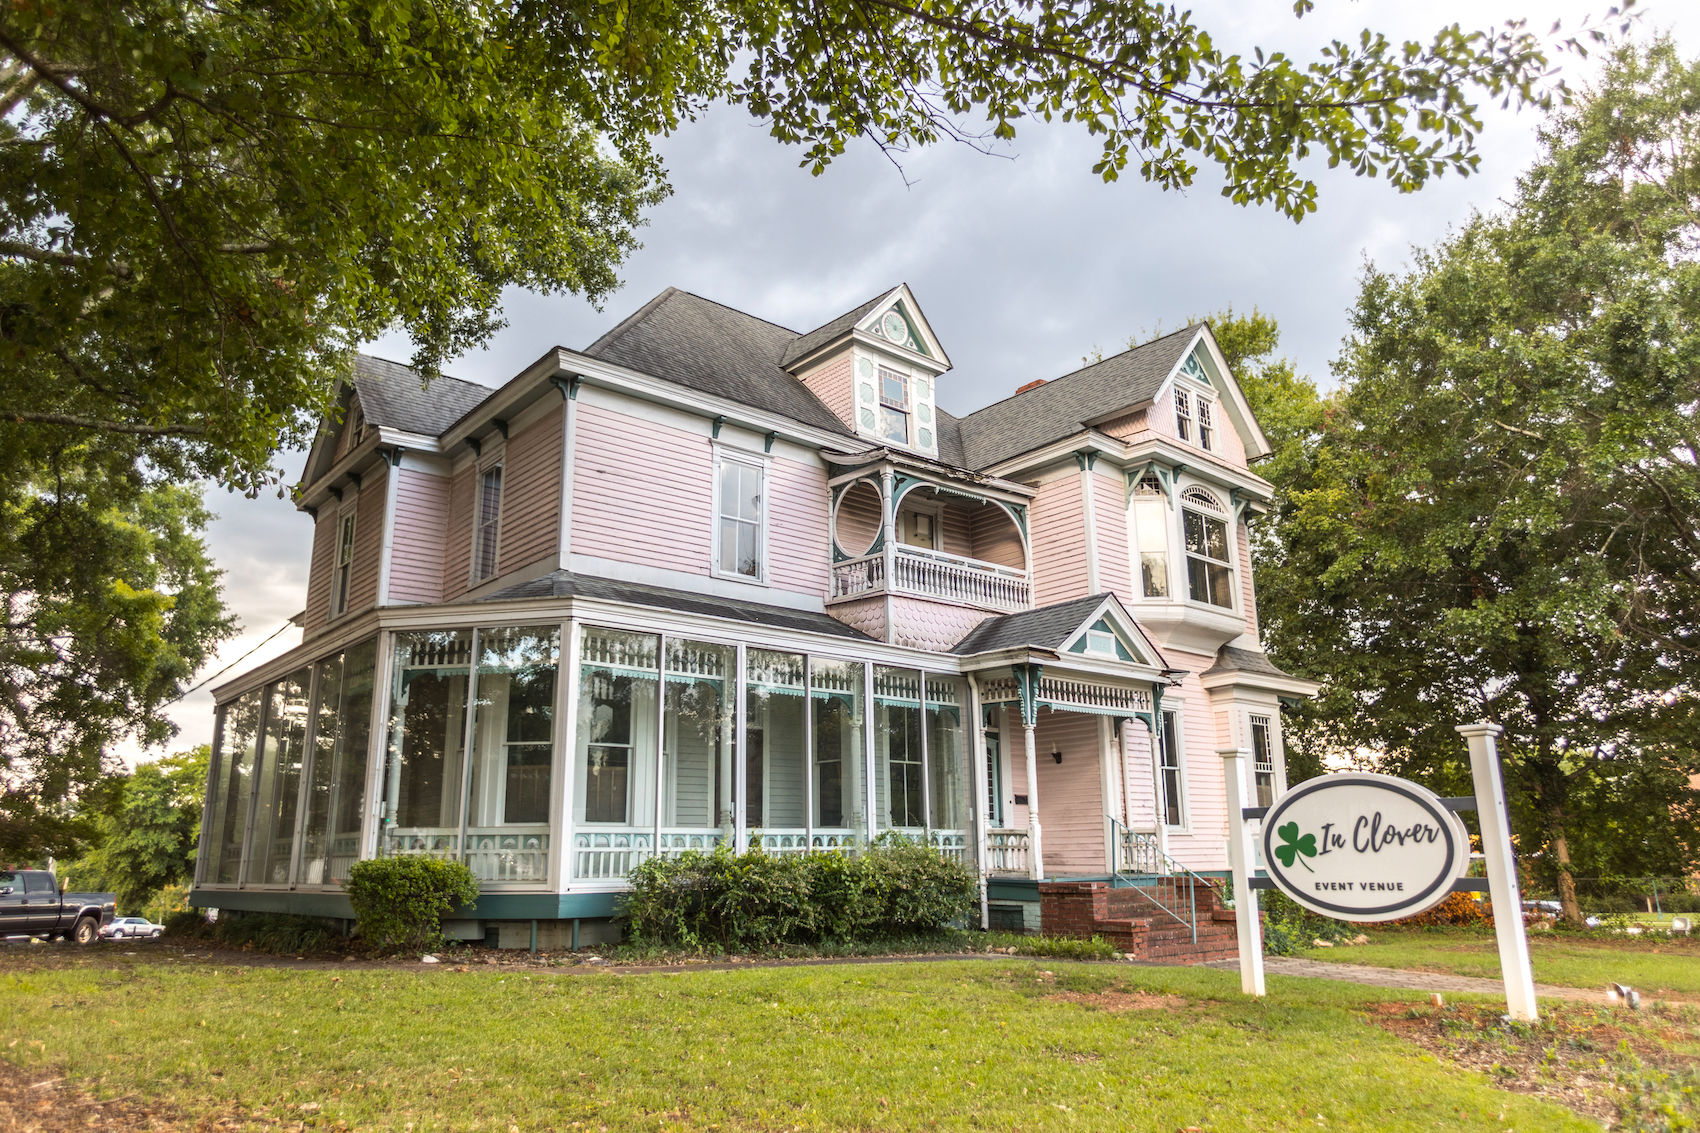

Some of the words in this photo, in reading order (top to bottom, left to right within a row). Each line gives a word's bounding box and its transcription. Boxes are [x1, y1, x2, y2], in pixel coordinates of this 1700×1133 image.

[1318, 823, 1346, 856] In
[1353, 811, 1440, 853] Clover
[1315, 882, 1354, 891] EVENT
[1359, 882, 1404, 891] VENUE
